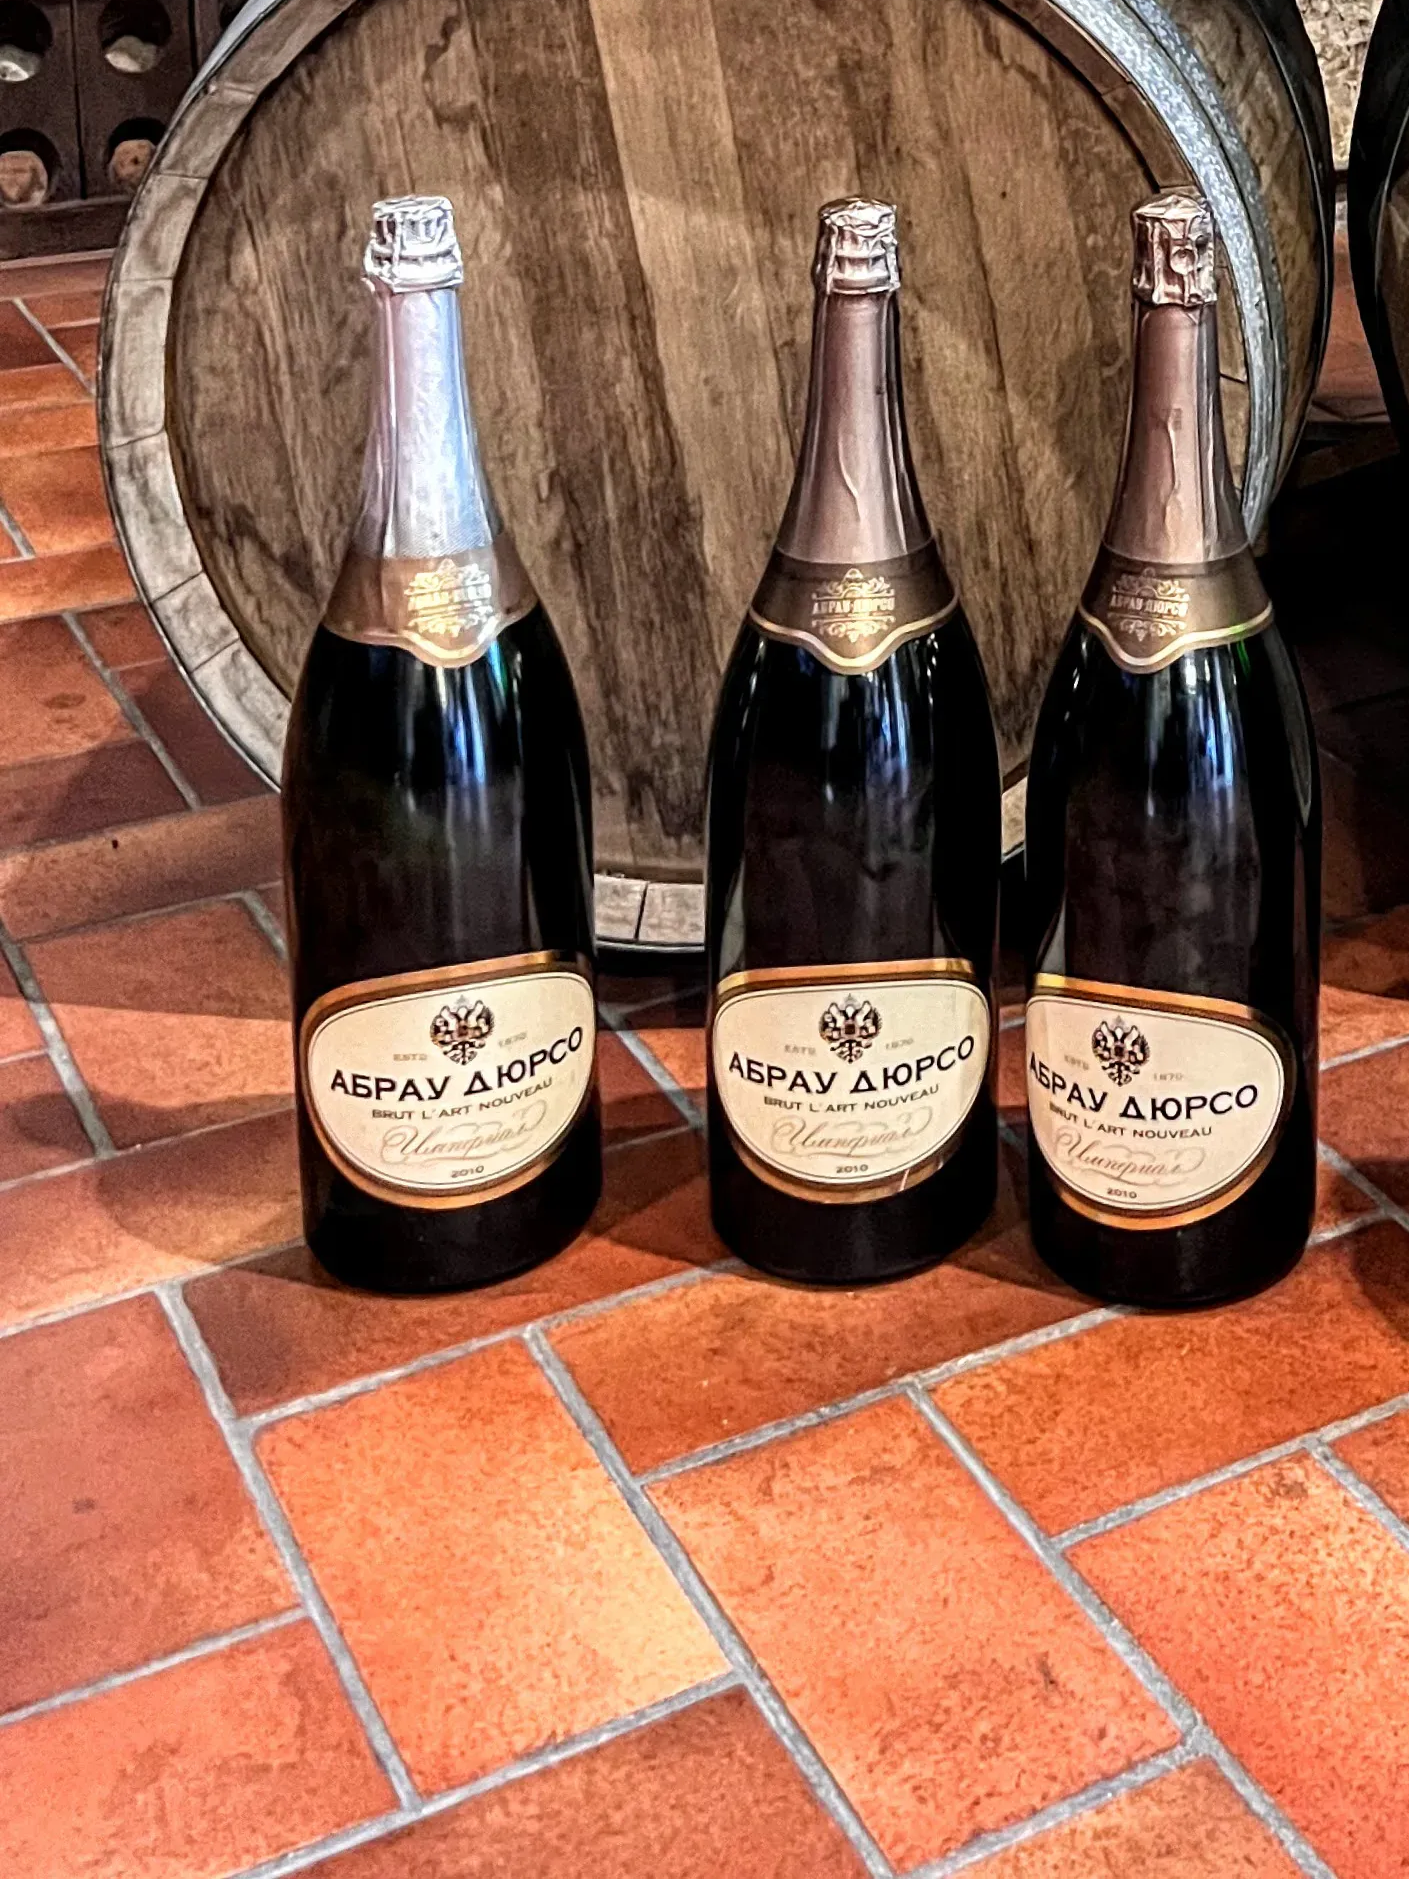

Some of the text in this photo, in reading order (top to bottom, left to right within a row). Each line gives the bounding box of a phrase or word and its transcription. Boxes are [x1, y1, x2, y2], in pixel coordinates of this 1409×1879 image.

[330, 1026, 583, 1102] АБРАУ ДЮРСО
[729, 1035, 975, 1094] АБРАУ ДЮРСО
[372, 1108, 415, 1120] BRUT
[479, 1077, 553, 1112] NOUVEAU
[763, 1095, 802, 1111] BRUT
[864, 1083, 940, 1111] NOUVEAU
[1028, 1051, 1258, 1121] АБРАУ ДЮРСО
[1049, 1101, 1078, 1124] BRUT
[1133, 1126, 1212, 1139] NOUVEAU
[450, 1165, 485, 1179] 2010
[835, 1164, 869, 1174] 2010
[1106, 1187, 1137, 1199] 2010
